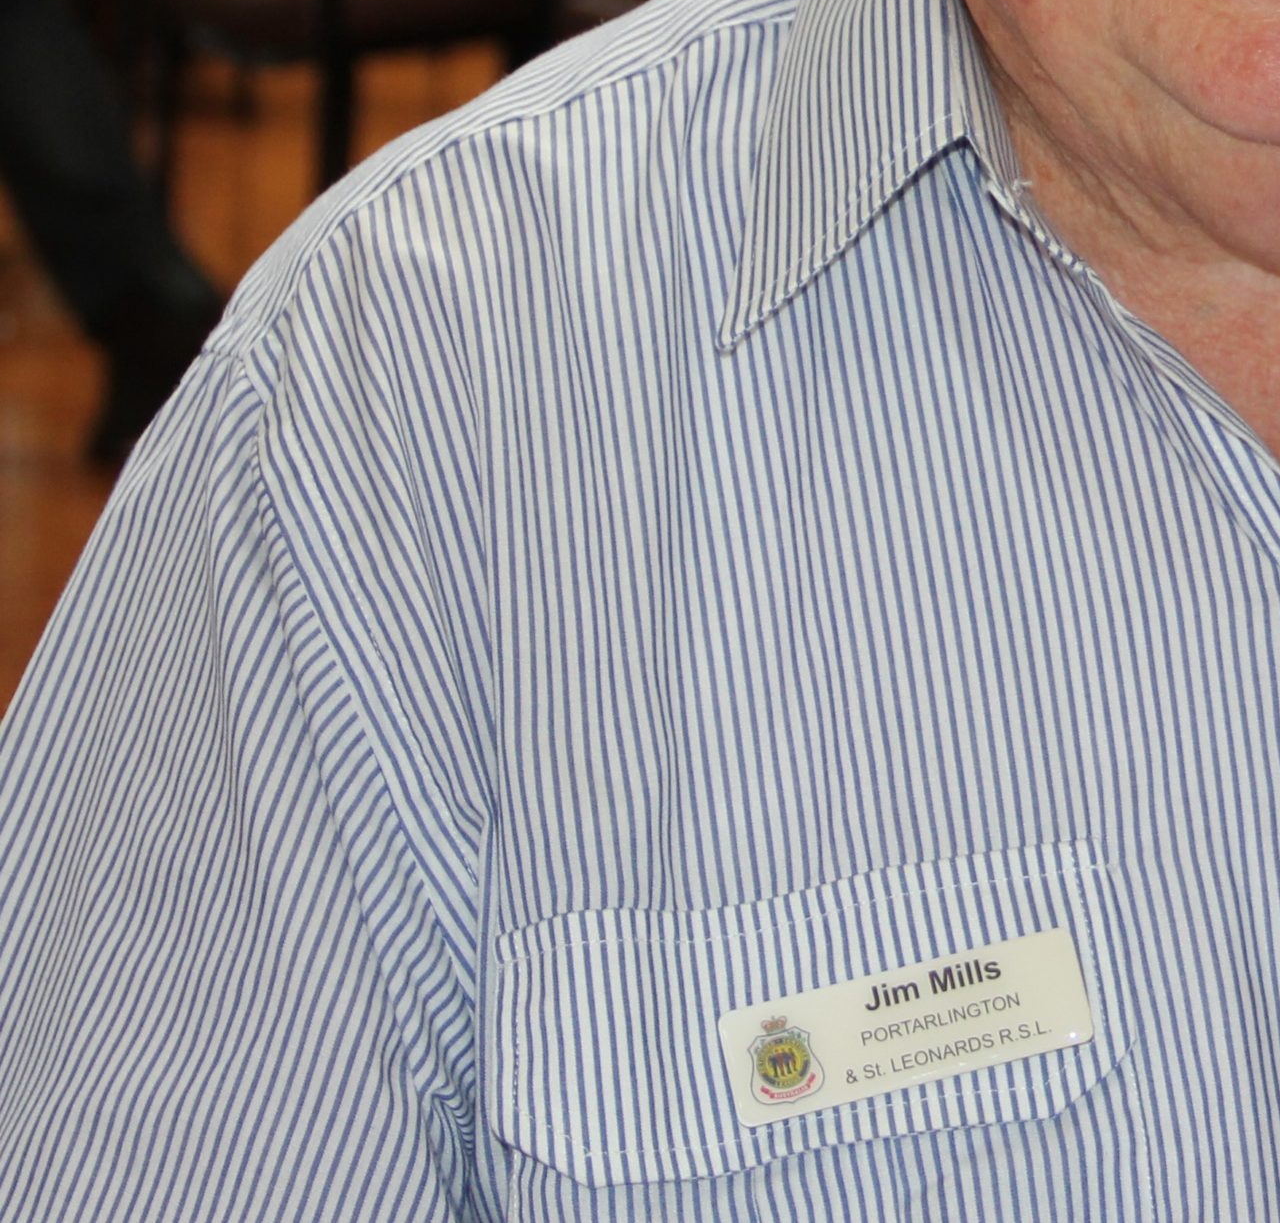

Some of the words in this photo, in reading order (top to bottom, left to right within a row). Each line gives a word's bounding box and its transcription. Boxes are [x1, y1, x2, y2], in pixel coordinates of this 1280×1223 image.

[864, 982, 920, 1011] Jim
[928, 958, 1002, 995] Mills
[860, 992, 1021, 1047] PORTARLINGTON
[845, 1068, 859, 1085] &
[863, 1062, 886, 1080] St.
[890, 1033, 995, 1074] LEONARDS
[999, 1020, 1053, 1045] R.S.L.
